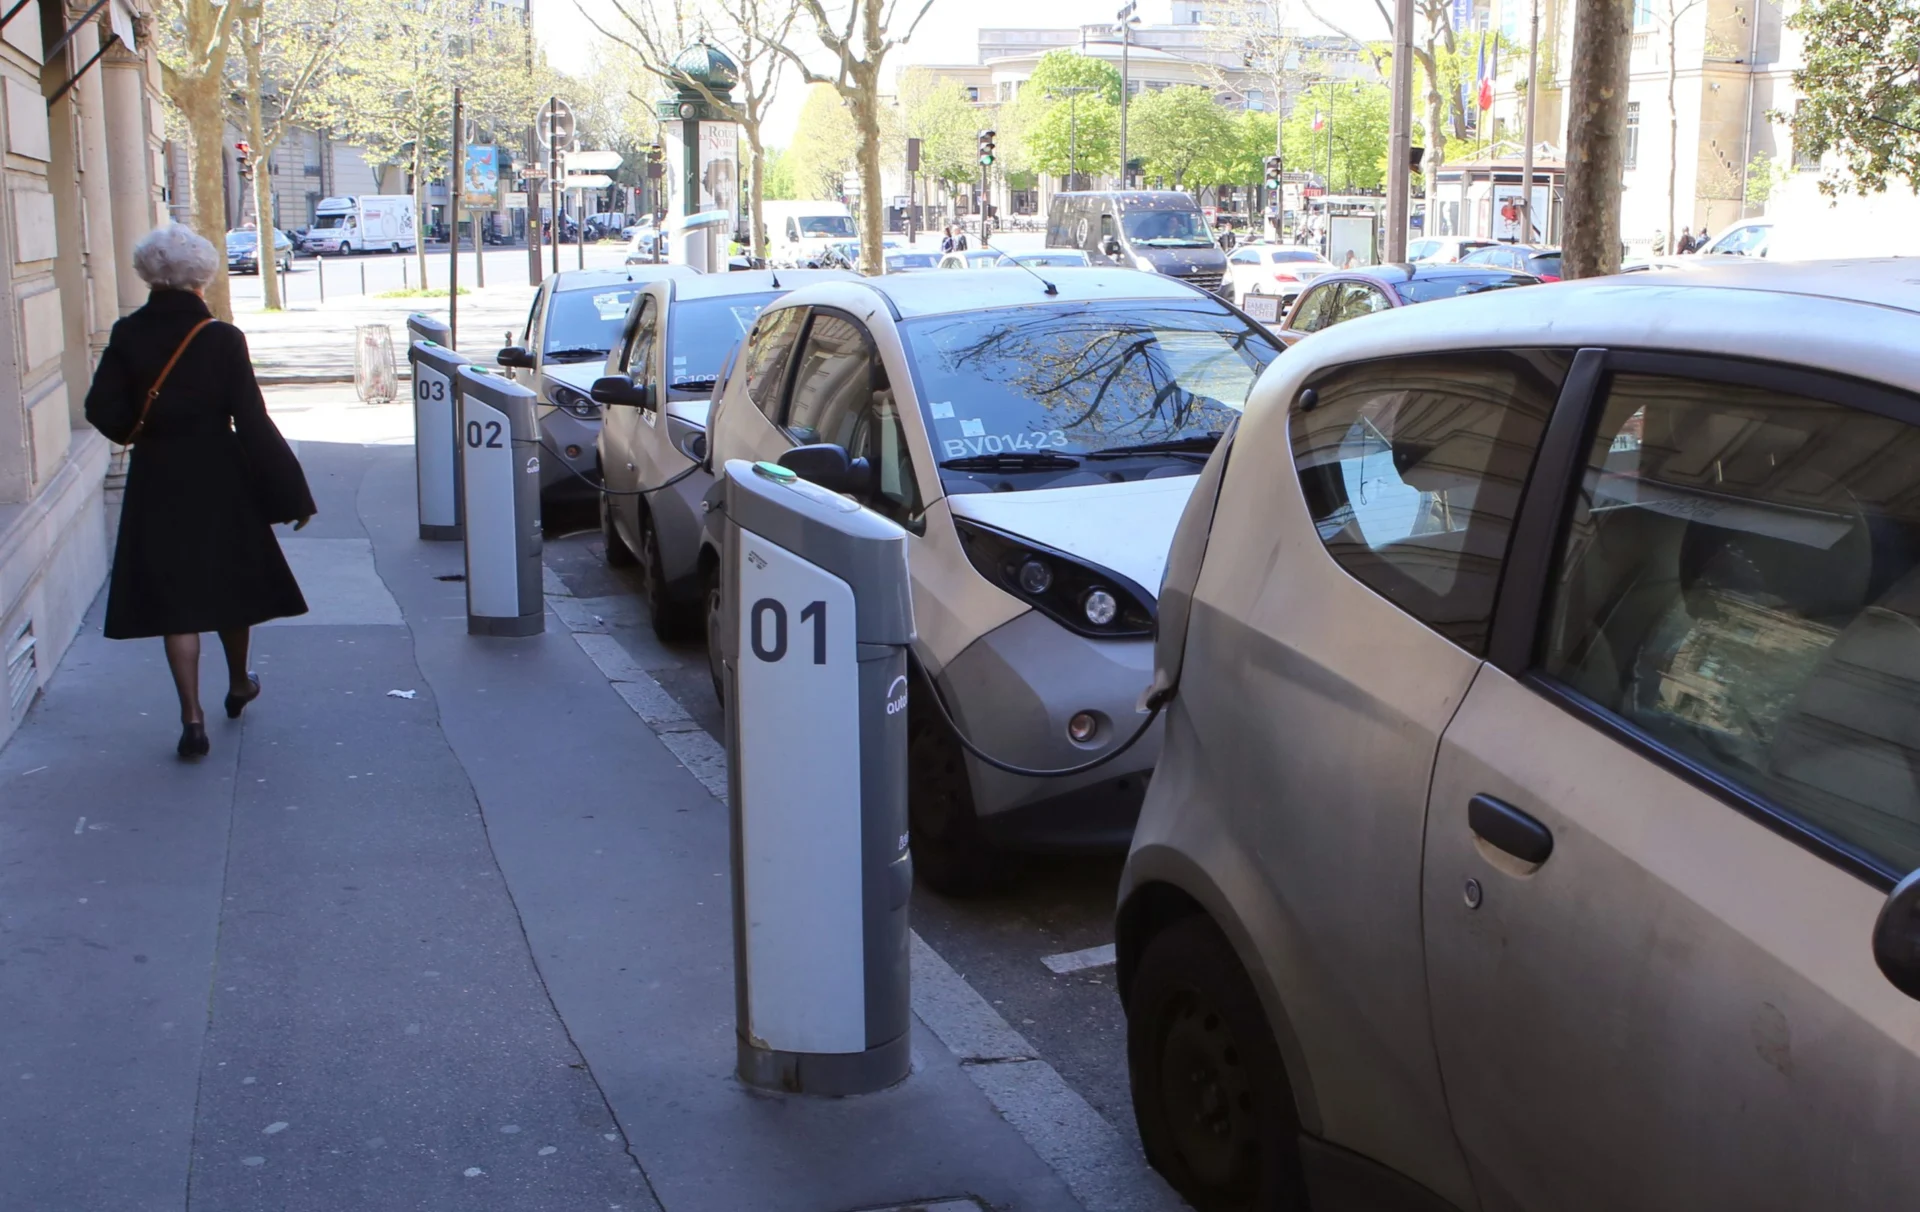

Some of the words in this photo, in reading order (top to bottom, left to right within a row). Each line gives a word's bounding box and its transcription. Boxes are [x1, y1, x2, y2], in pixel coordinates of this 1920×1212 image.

[419, 380, 445, 401] 03
[466, 420, 503, 449] 02
[943, 429, 1069, 458] BV01423
[750, 597, 828, 666] 01
